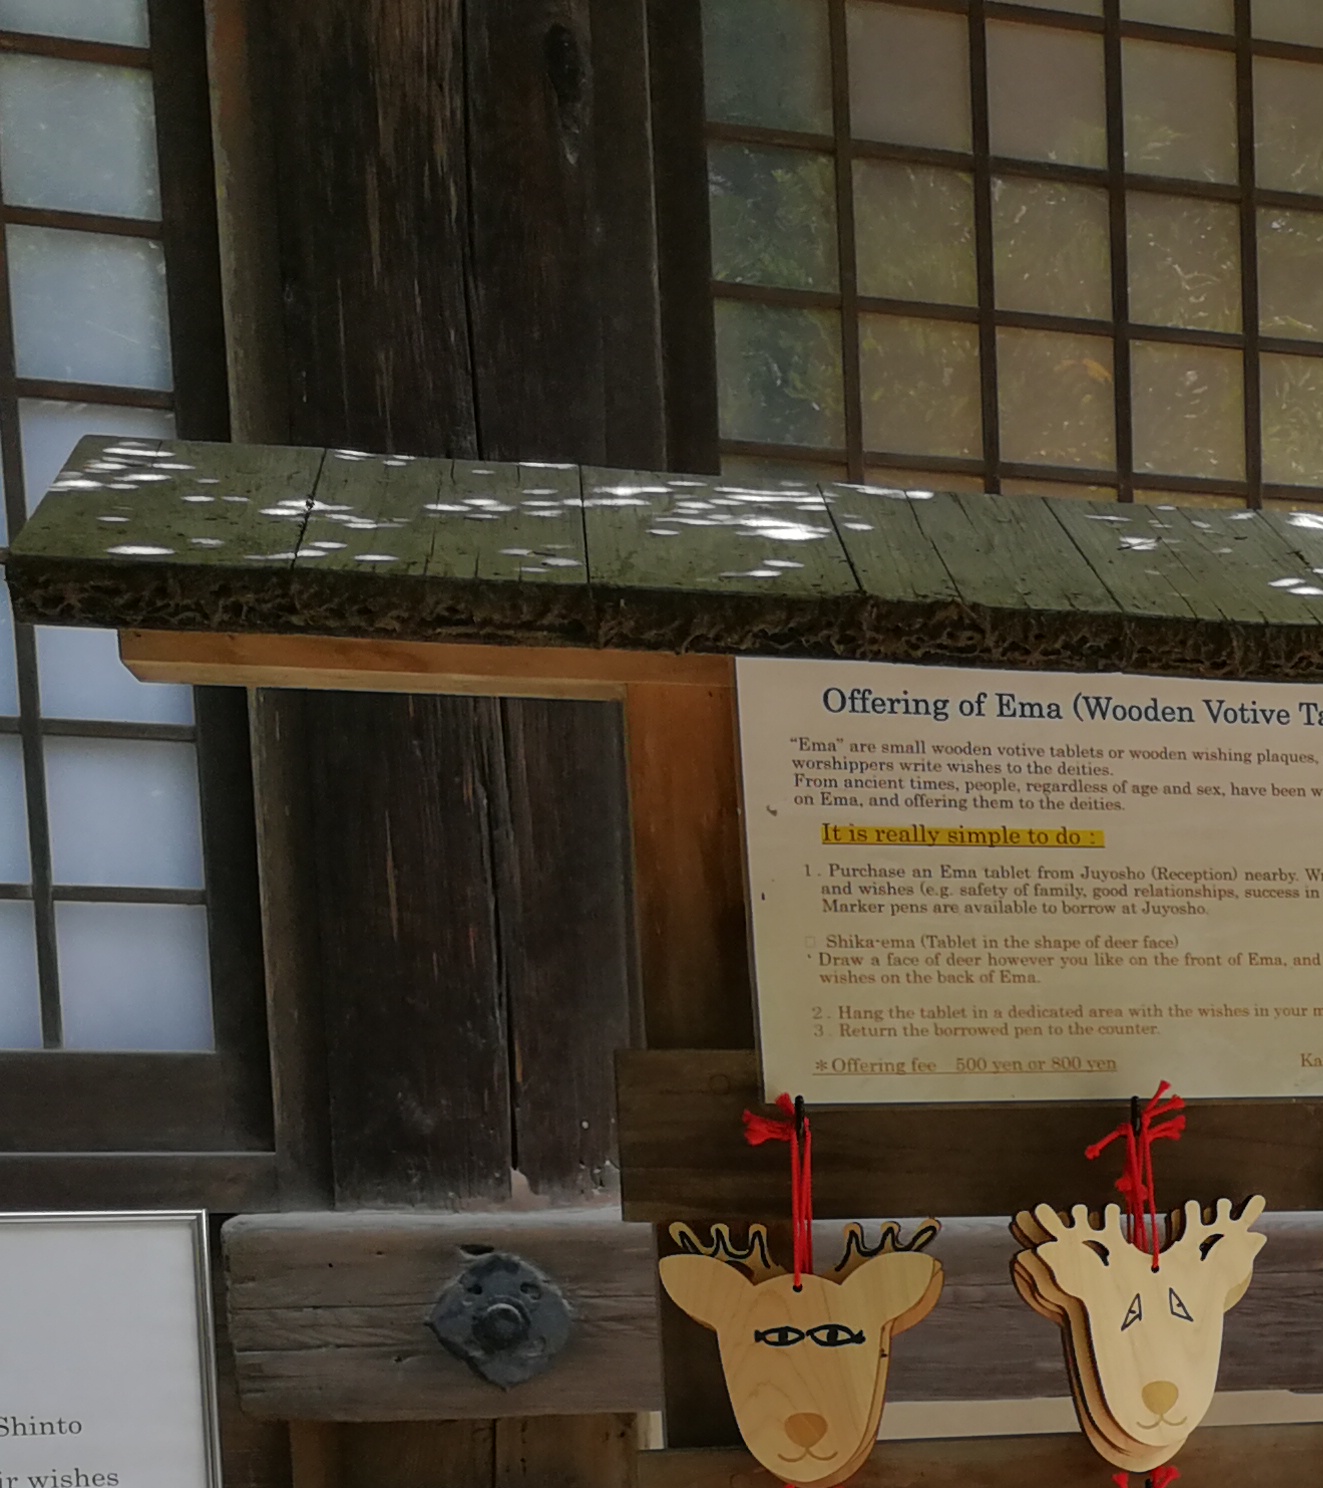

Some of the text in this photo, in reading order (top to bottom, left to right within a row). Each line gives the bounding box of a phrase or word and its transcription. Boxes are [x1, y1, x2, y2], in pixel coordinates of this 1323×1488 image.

[823, 688, 950, 722] Offering
[959, 692, 988, 717] of
[996, 693, 1063, 720] Ema
[1073, 692, 1195, 723] (Wooden
[1202, 699, 1290, 726] Votive
[850, 743, 876, 753] are
[881, 740, 926, 755] small
[931, 741, 992, 756] wooden
[997, 743, 1045, 758] votive
[1049, 744, 1104, 759] tablets
[1108, 749, 1125, 759] or
[1129, 746, 1187, 761] wooden
[1192, 747, 1252, 765] wishing
[1257, 749, 1319, 766] plaques,
[792, 756, 1113, 776] worshippers write wishes to the deities.
[795, 773, 838, 789] From
[843, 778, 905, 790] ancient
[910, 777, 959, 792] times,
[964, 778, 1020, 795] people,
[1026, 779, 1108, 796] regardless
[1112, 780, 1126, 794] of
[1131, 785, 1158, 797] age
[1163, 781, 1192, 795] and
[1196, 786, 1226, 797] sex,
[1231, 782, 1267, 797] have
[1271, 783, 1306, 797] been
[822, 822, 843, 841] It
[849, 824, 869, 842] is
[875, 824, 941, 847] really
[948, 826, 1022, 848] simple
[1027, 828, 1050, 844] to
[1056, 825, 1082, 845] do
[829, 863, 906, 878] Purchase
[912, 868, 933, 879] an
[941, 864, 977, 879] Ema
[984, 865, 1031, 880] tablet
[1037, 865, 1074, 880] from
[1080, 866, 1145, 880] Juyosho
[1151, 866, 1238, 884] (Reception)
[1245, 868, 1298, 885] nearby.
[821, 881, 853, 895] and
[858, 881, 914, 896] wishes
[920, 881, 953, 899] (e.g.
[960, 882, 1008, 900] safety
[1013, 883, 1028, 897] of
[1033, 883, 1087, 898] family,
[1092, 883, 1128, 900] good
[1134, 883, 1239, 901] relationships,
[1244, 889, 1300, 899] success
[1305, 886, 1320, 899] in
[911, 1057, 937, 1073] fee
[956, 1057, 988, 1073] 500
[992, 1060, 1024, 1075] yen
[1028, 1060, 1047, 1073] or
[1051, 1056, 1084, 1072] 800
[1087, 1058, 1118, 1075] yen
[0, 1416, 82, 1437] Shinto
[27, 1468, 119, 1488] wishes
